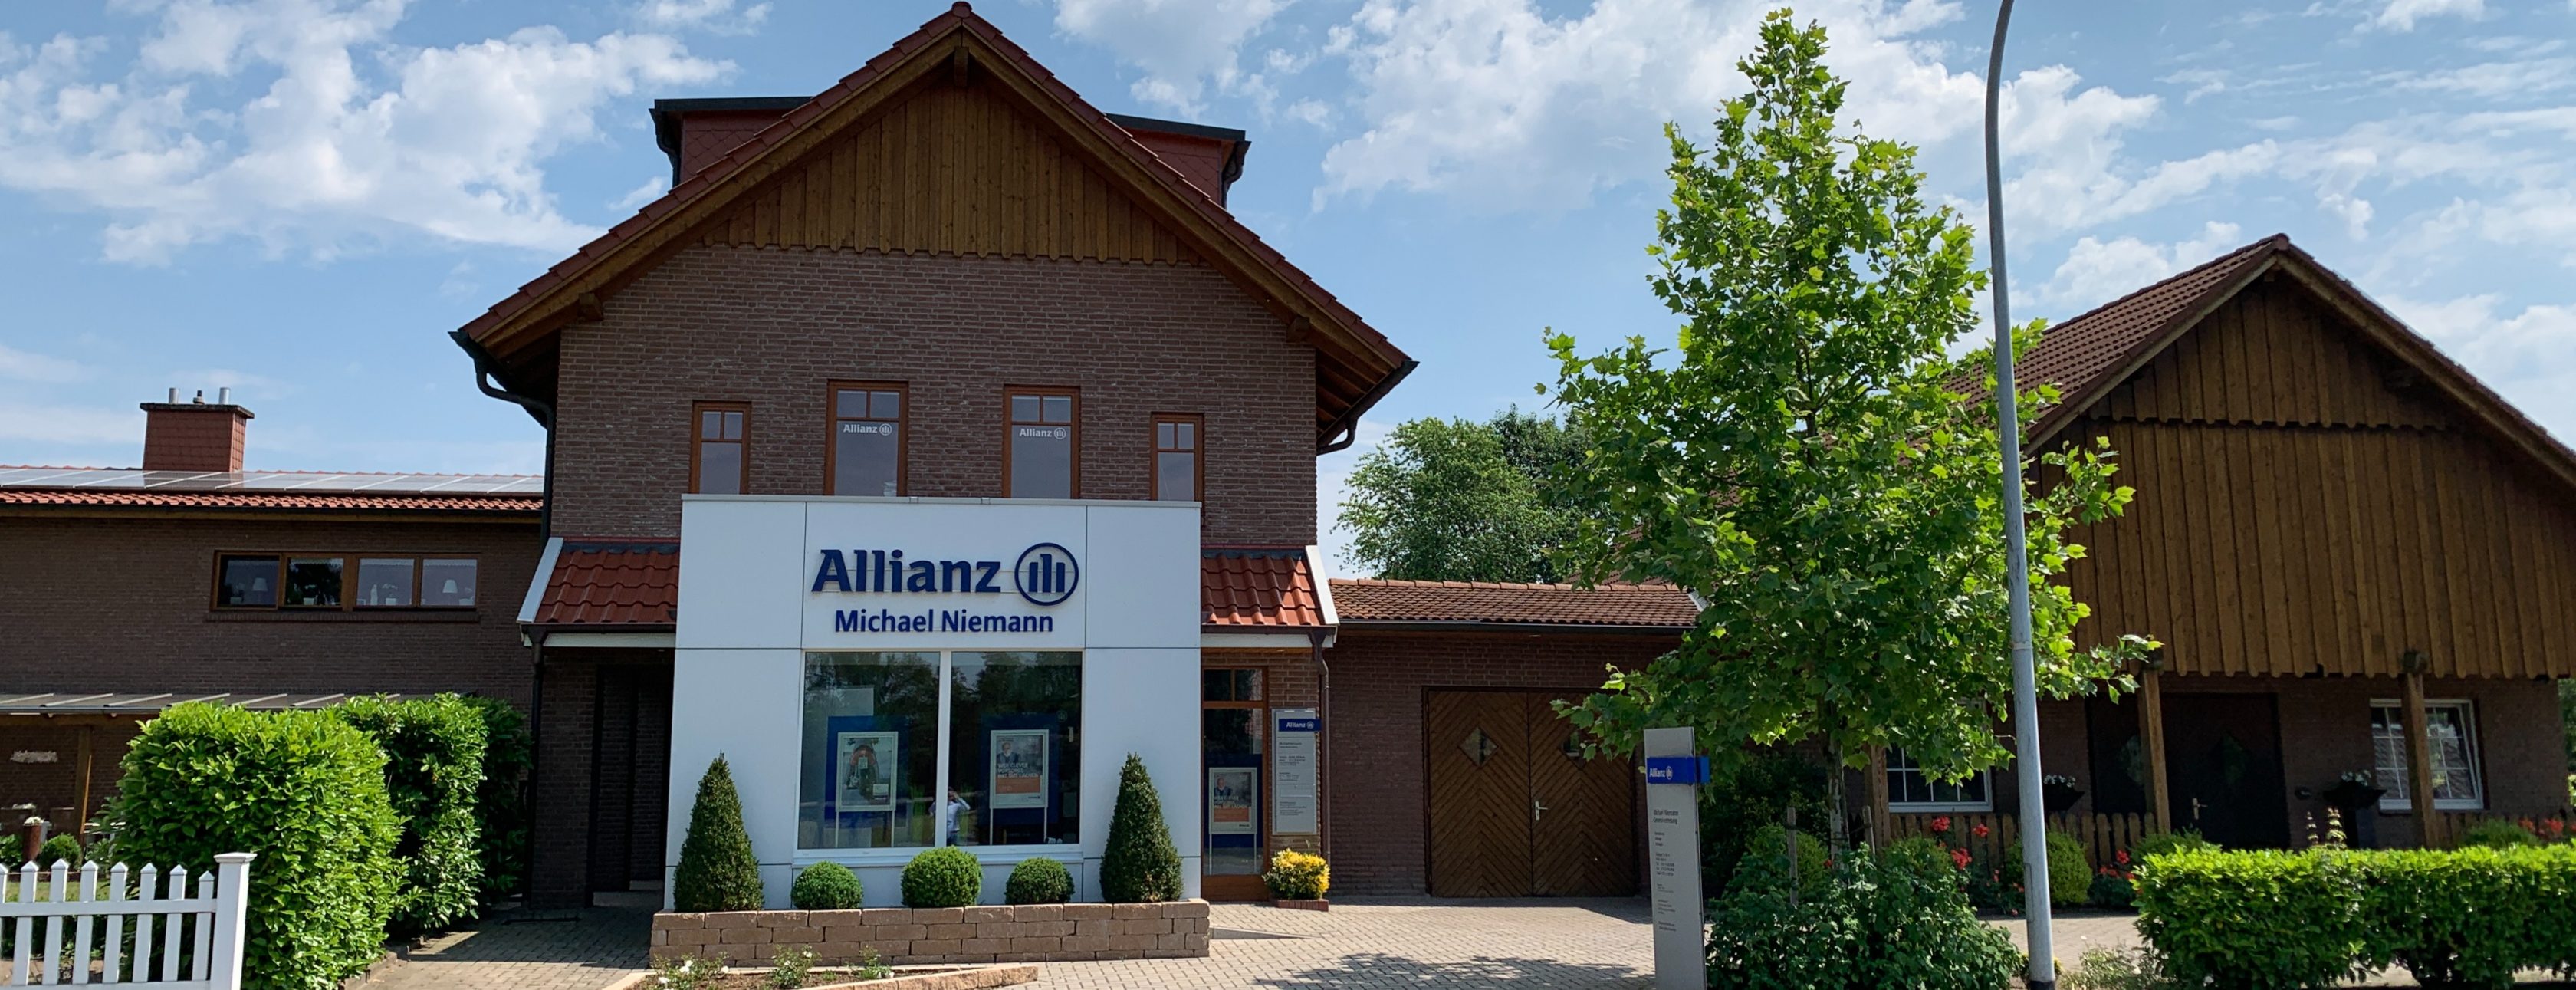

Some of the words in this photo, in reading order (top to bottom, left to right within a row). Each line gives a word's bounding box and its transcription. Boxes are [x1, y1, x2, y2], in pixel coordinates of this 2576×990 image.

[843, 424, 878, 433] Allianz
[1020, 428, 1053, 437] Allianz
[811, 549, 1001, 593] Allianz
[835, 609, 934, 633] Michael
[942, 609, 1053, 633] Niemann
[1649, 768, 1666, 778] Allianz
